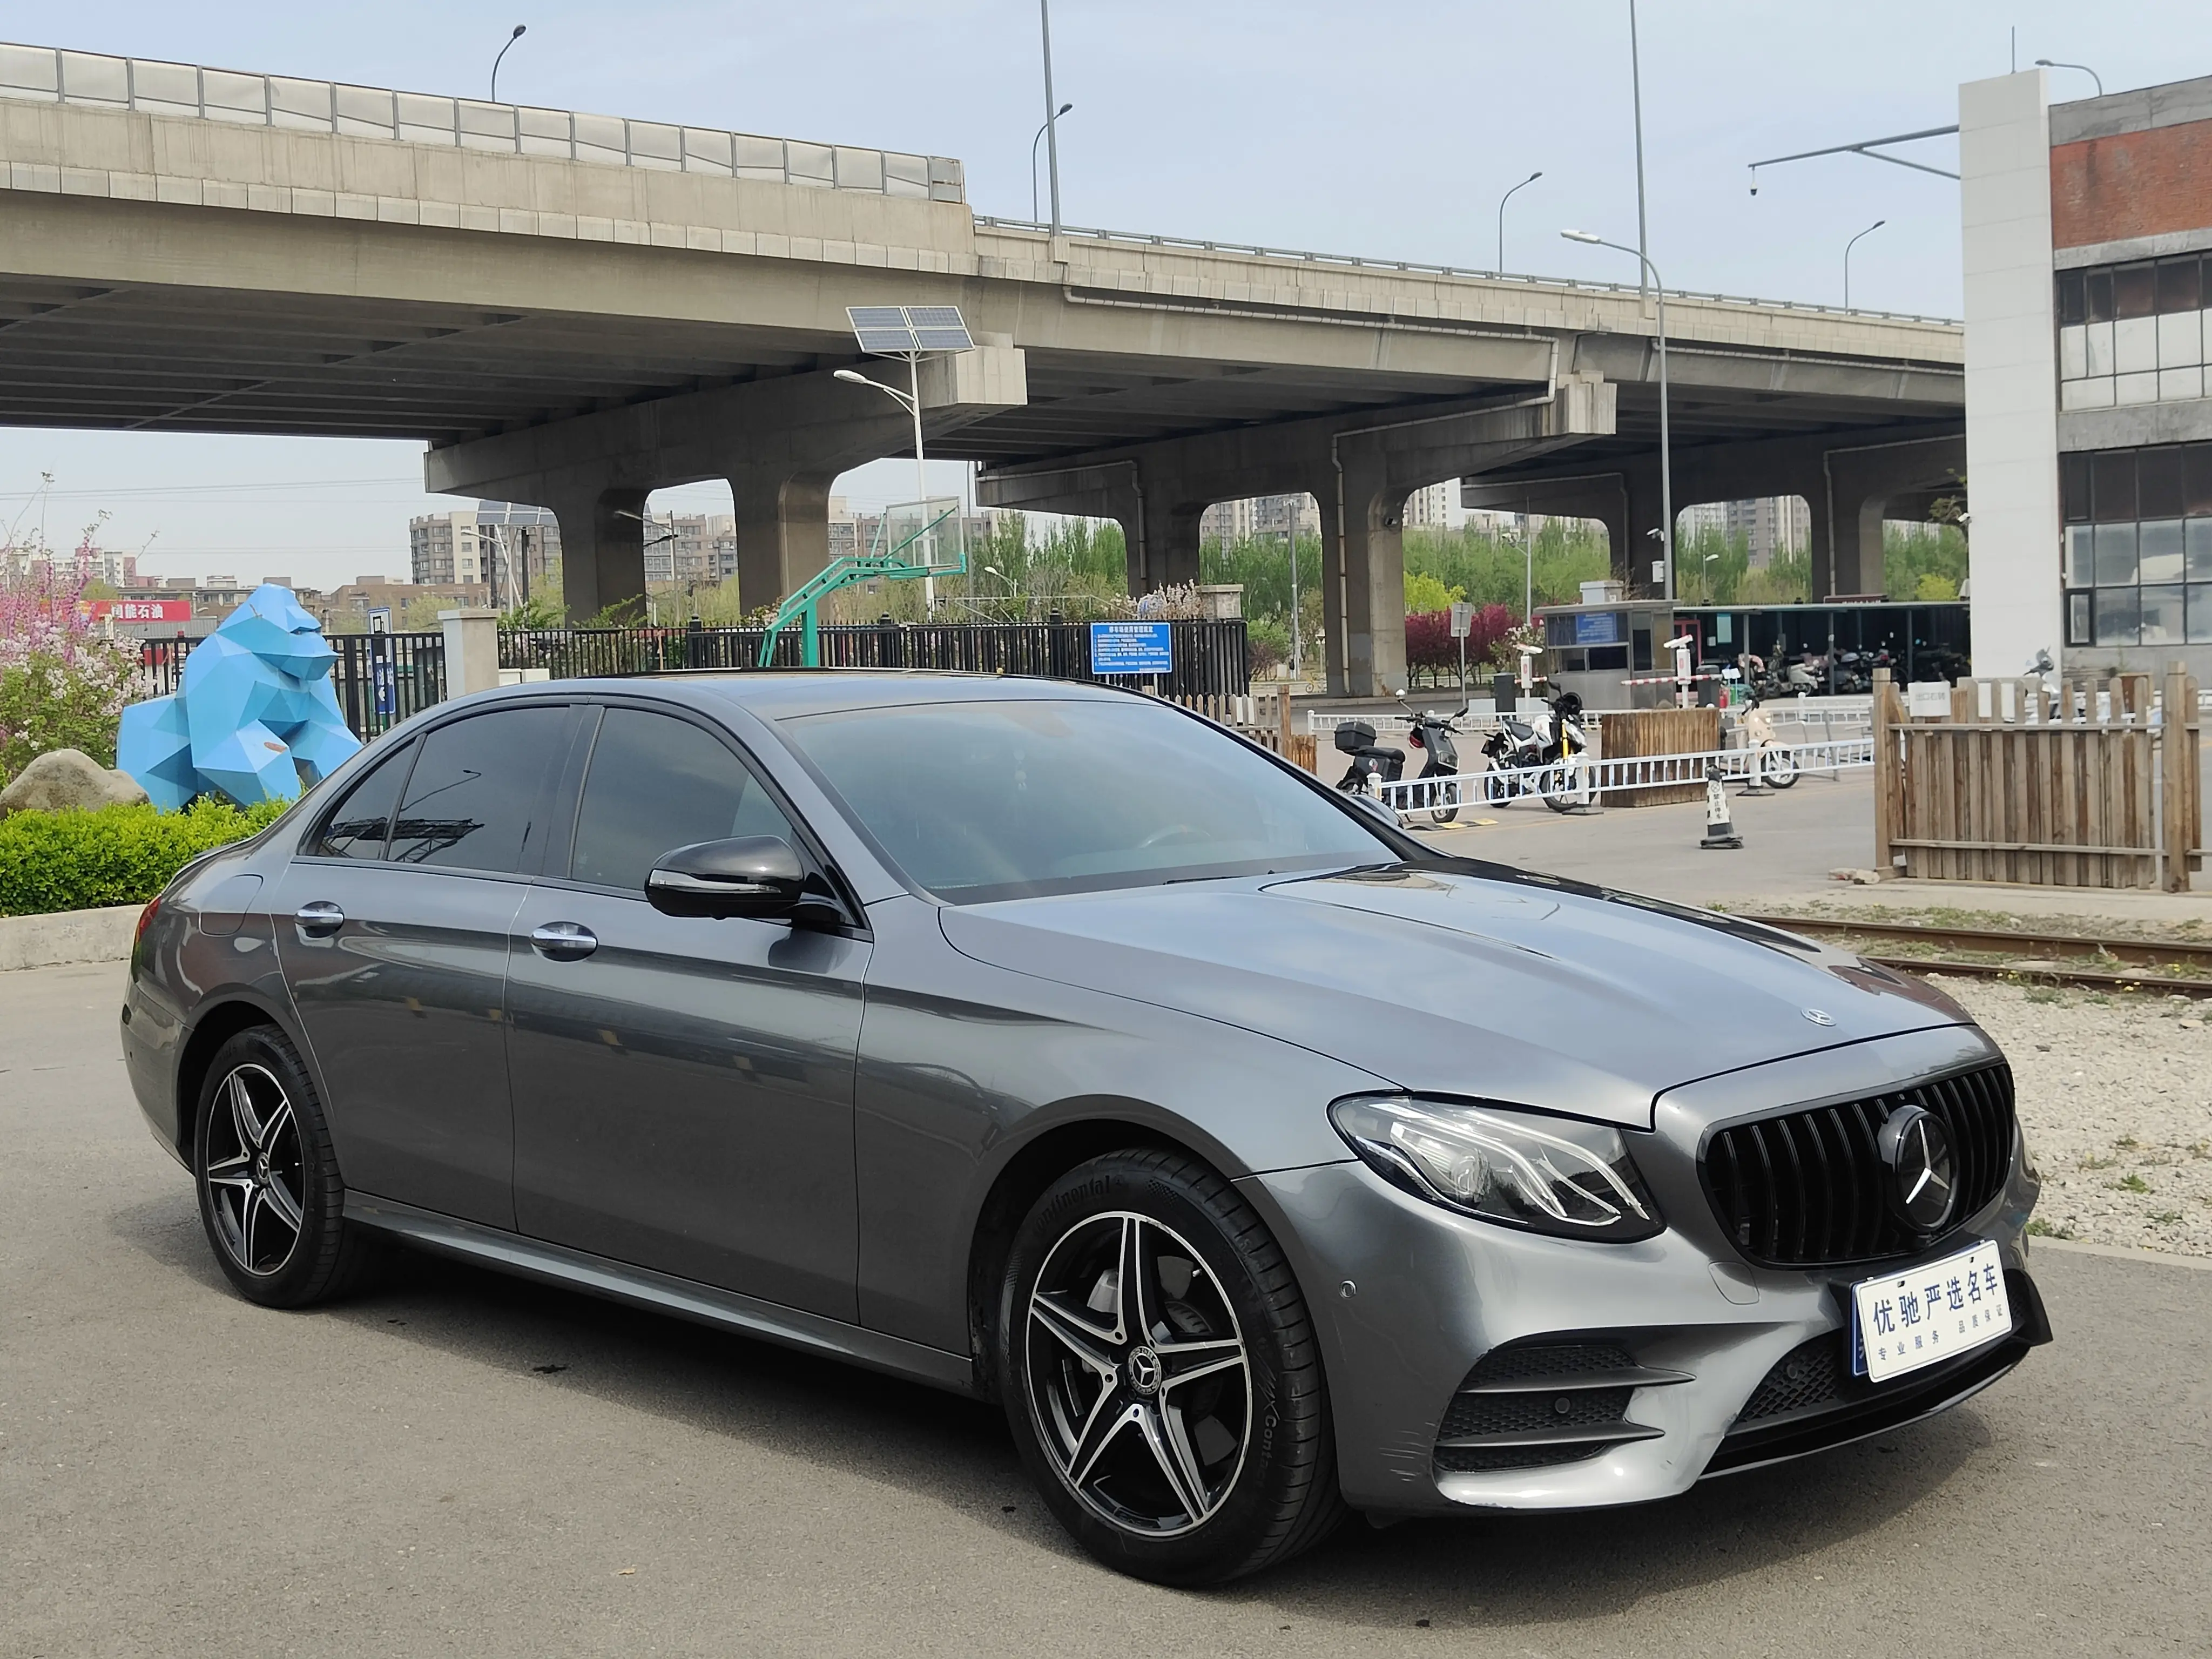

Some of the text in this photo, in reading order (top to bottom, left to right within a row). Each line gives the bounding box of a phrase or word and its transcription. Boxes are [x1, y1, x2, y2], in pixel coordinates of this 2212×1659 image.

[1873, 1263, 1998, 1336] 优驰严选名车
[1878, 1330, 1939, 1360] 专业服务
